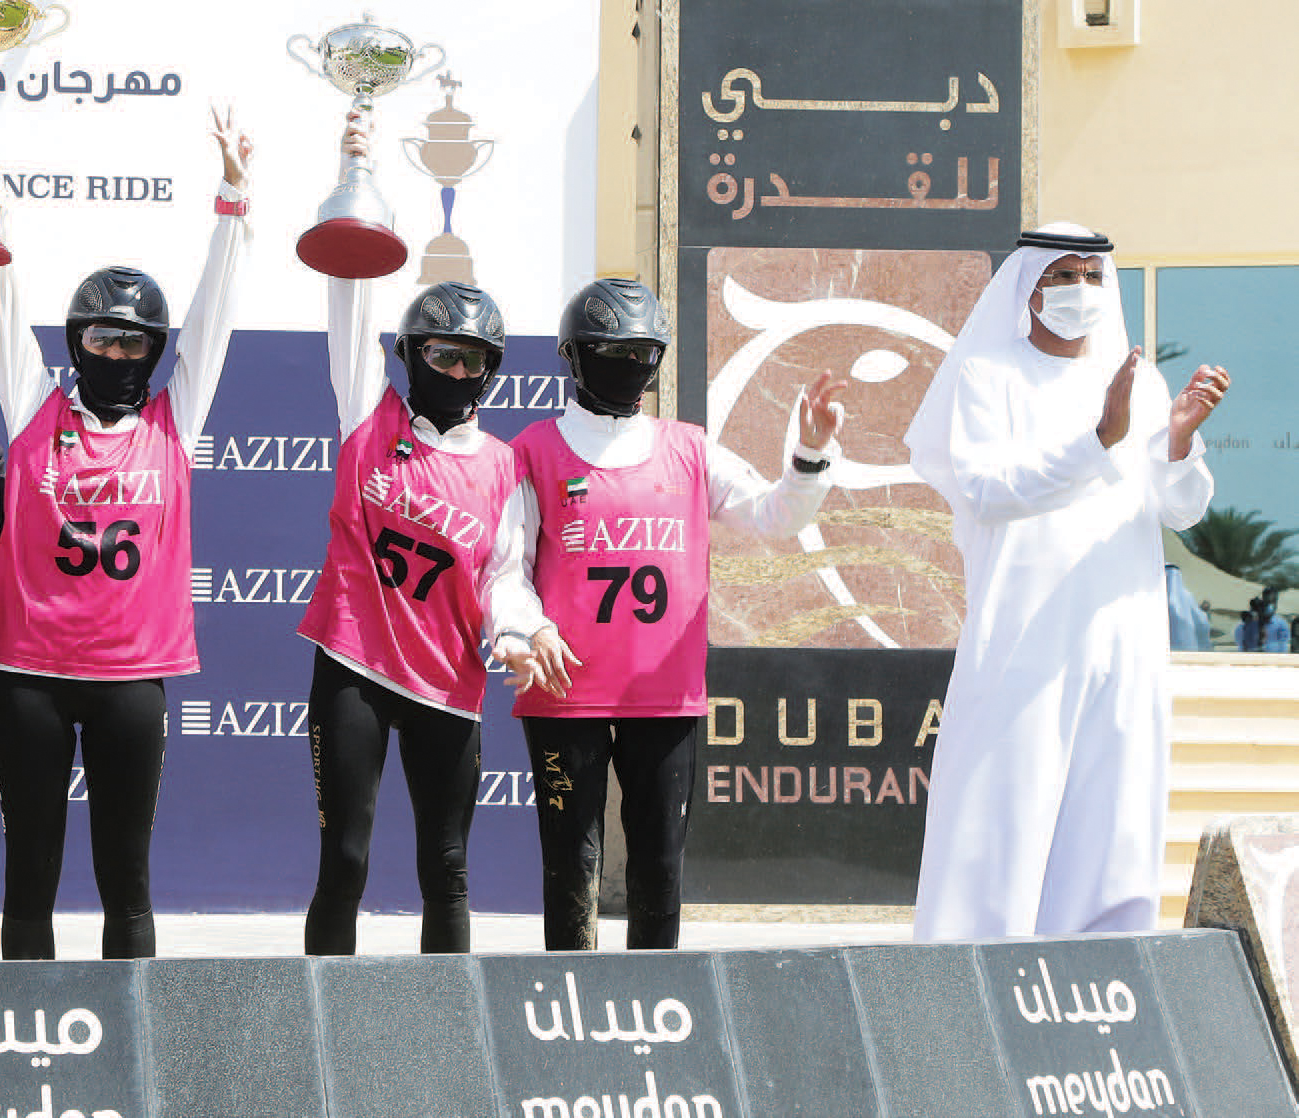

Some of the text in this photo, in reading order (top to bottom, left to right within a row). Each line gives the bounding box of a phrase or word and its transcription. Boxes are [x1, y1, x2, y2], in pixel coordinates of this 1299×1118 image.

[17, 61, 182, 104] مهرجان
[701, 67, 999, 141] دبي
[86, 175, 173, 202] RIDE
[706, 152, 1000, 220] للقدرة
[477, 374, 570, 410] ZIZI
[215, 436, 333, 471] AZIZI
[58, 469, 165, 506] AZIZI
[560, 494, 587, 508] UAE
[54, 519, 141, 581] 56
[588, 517, 687, 553] AZIZI
[213, 568, 323, 603] AZIZ
[374, 526, 455, 603] 57
[587, 564, 669, 624] 79
[213, 701, 310, 737] AZIZ
[706, 697, 944, 748] DUBA
[706, 764, 932, 805] ENDURAN
[524, 971, 693, 1056] ميدان
[1013, 956, 1137, 1035] ميدان
[1025, 1047, 1176, 1118] meydan
